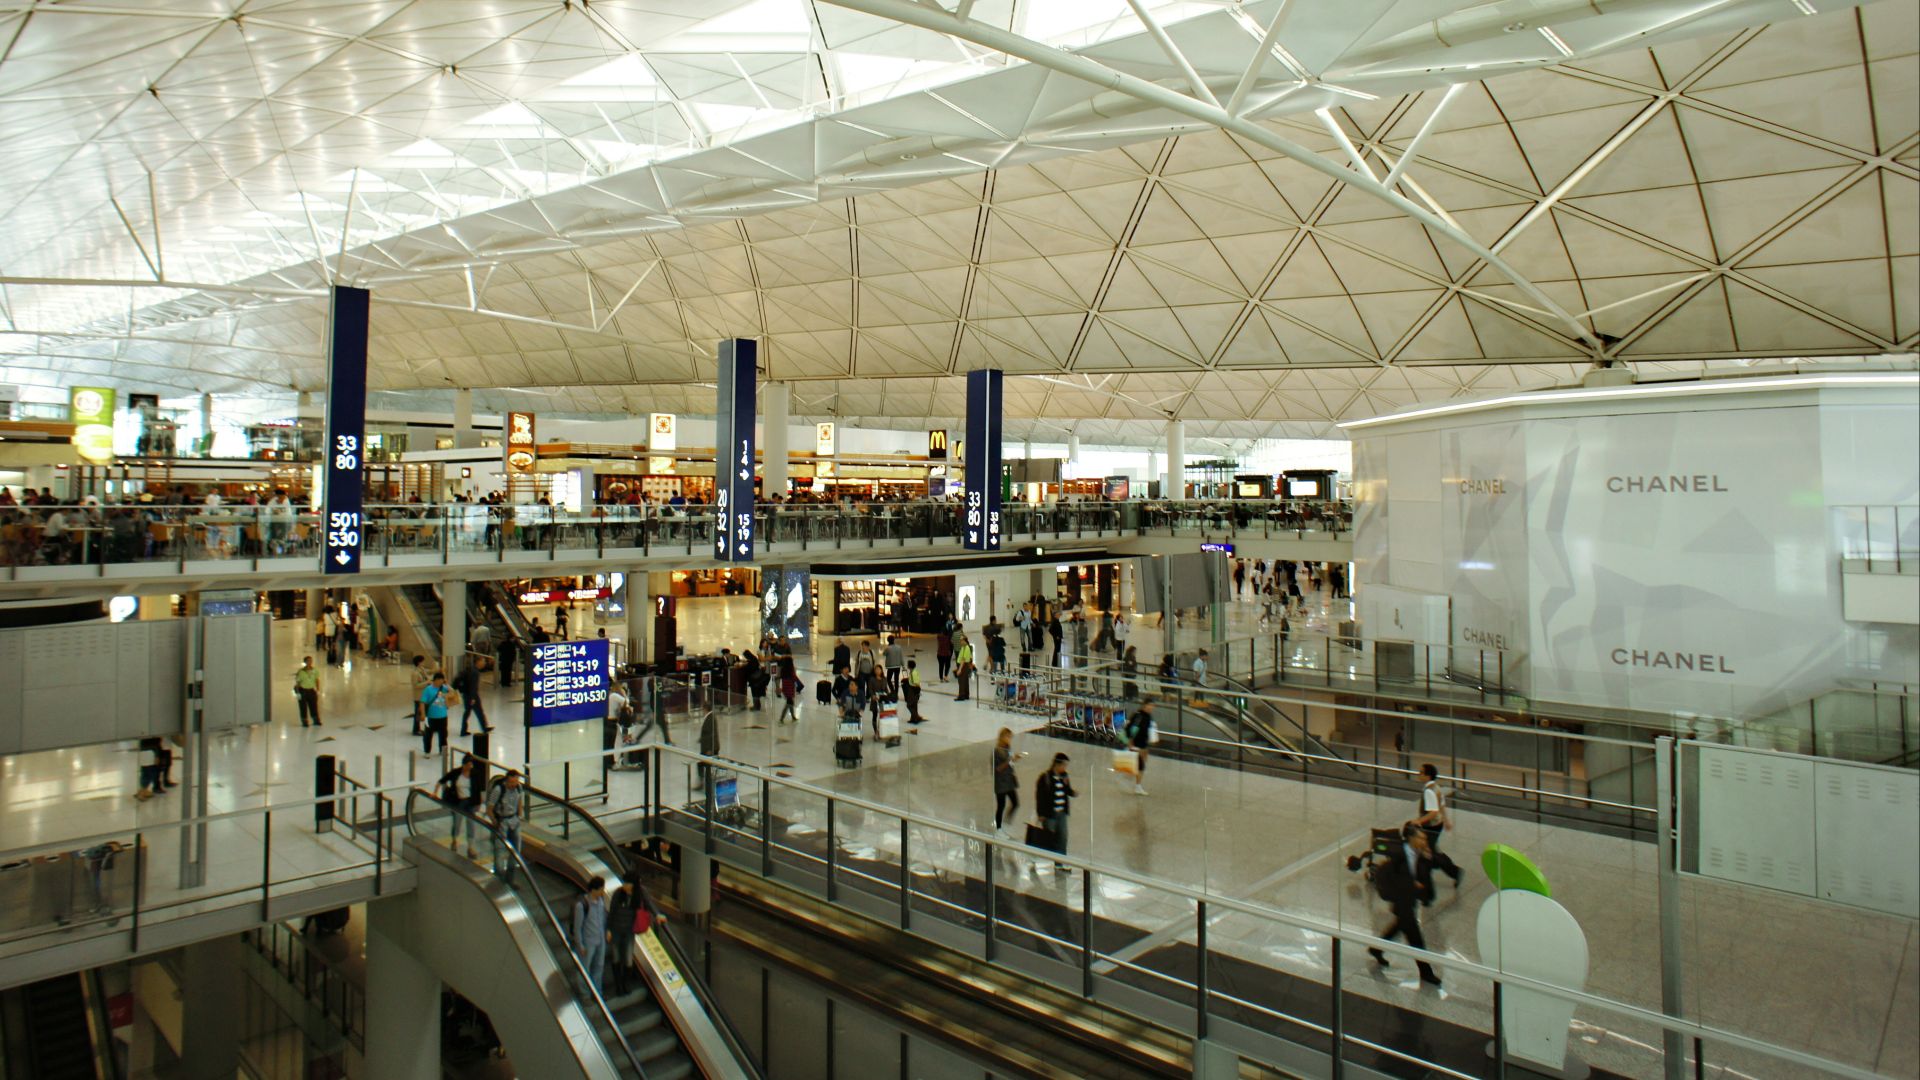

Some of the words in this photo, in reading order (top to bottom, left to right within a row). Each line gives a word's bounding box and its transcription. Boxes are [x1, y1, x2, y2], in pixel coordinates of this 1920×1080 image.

[336, 435, 357, 450] 33
[335, 454, 356, 470] 80
[1460, 479, 1506, 495] CHANEL
[1606, 475, 1728, 493] CHANEL
[718, 489, 728, 508] 20
[968, 491, 980, 507] 33
[330, 512, 358, 528] 501
[717, 513, 727, 531] 32
[738, 514, 750, 526] 15
[968, 510, 980, 526] 80
[990, 511, 998, 522] 33
[738, 529, 750, 541] 19
[990, 524, 998, 534] 80
[328, 532, 358, 546] 530
[1463, 628, 1510, 651] CHANEL
[572, 645, 586, 657] 1-4
[572, 659, 598, 673] 15-19
[1611, 648, 1735, 674] CHANEL
[571, 675, 601, 688] 33-80
[571, 690, 607, 704] 501-530
